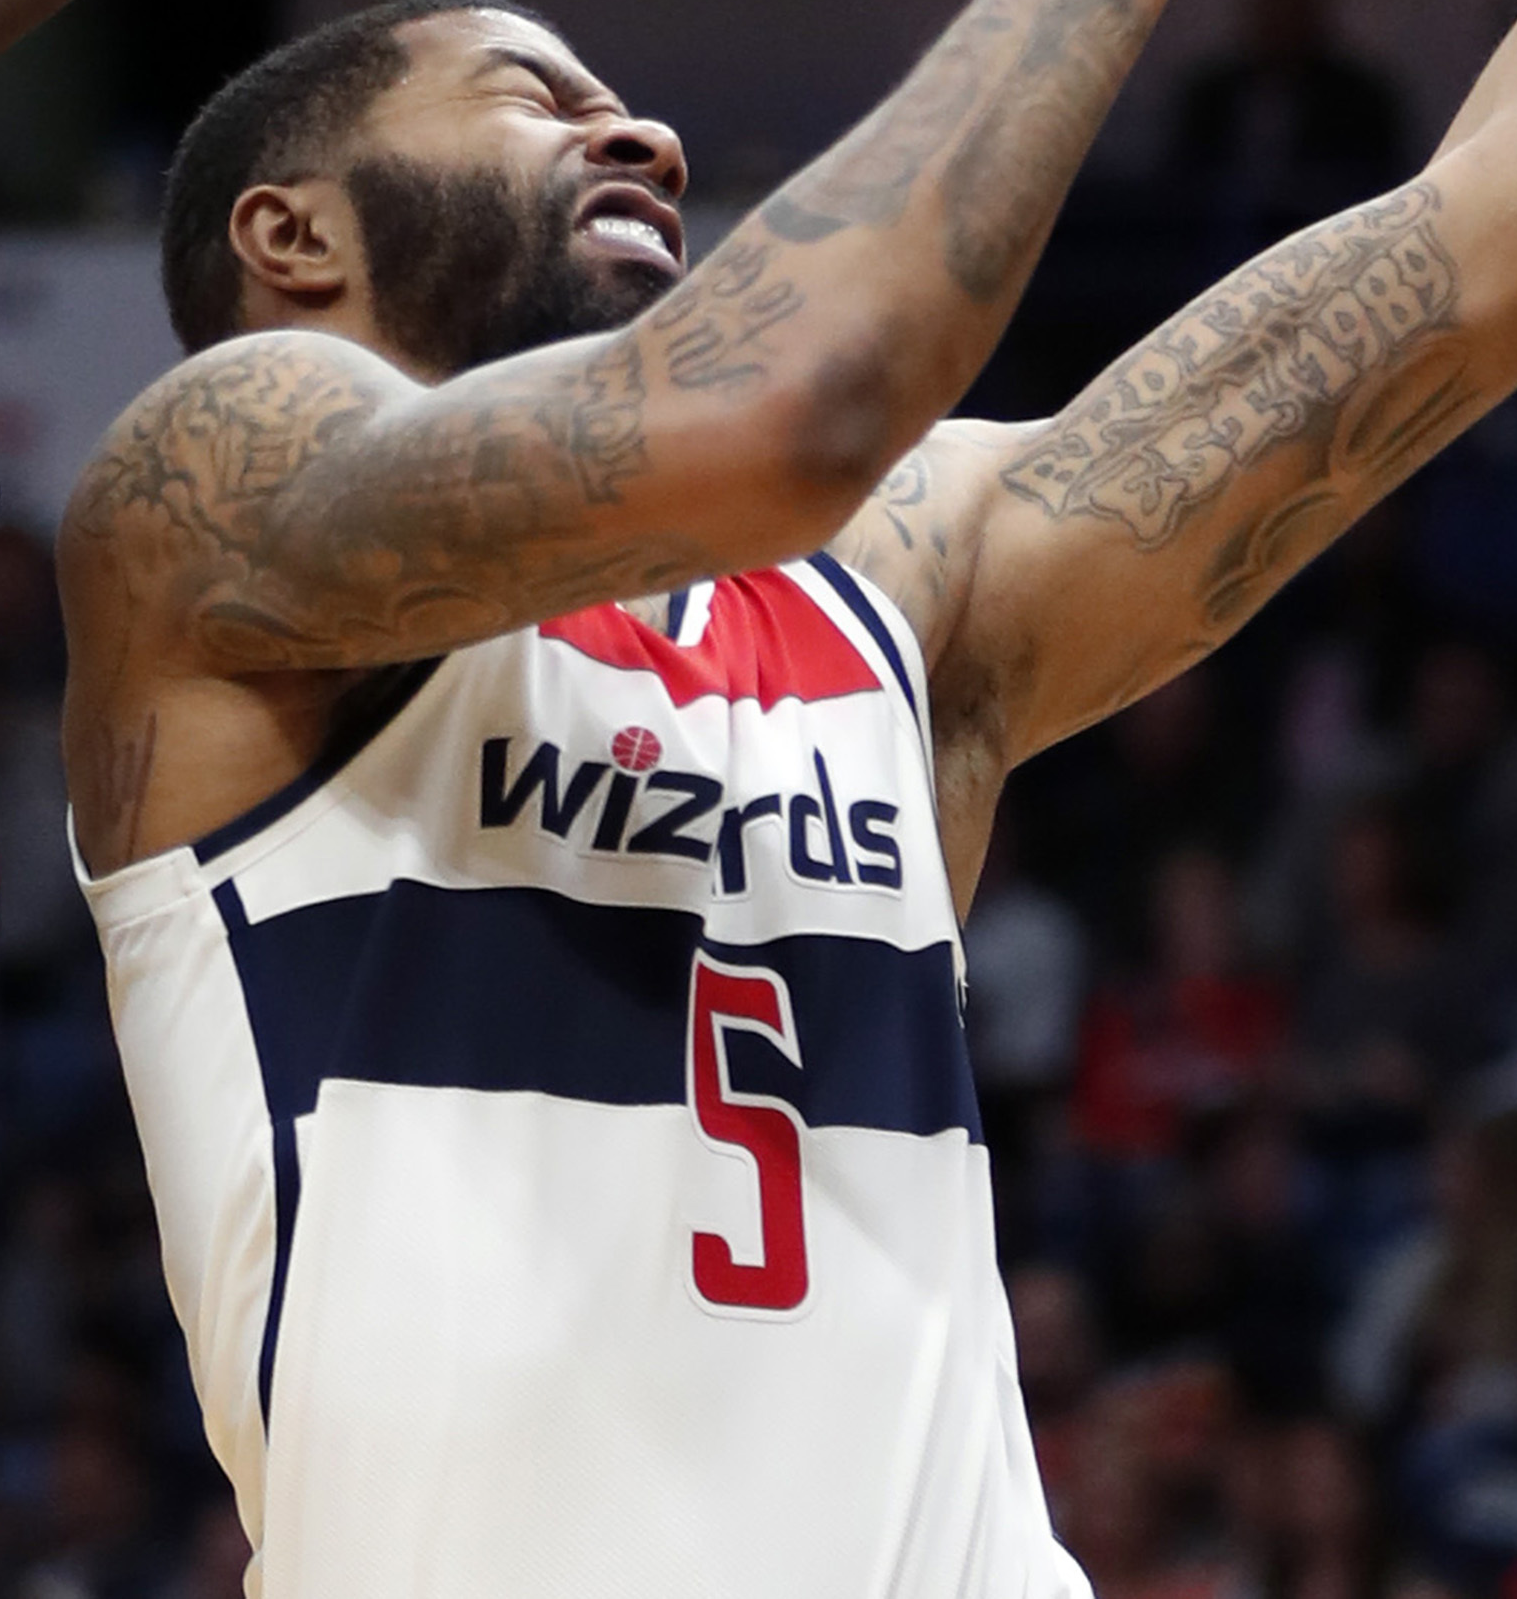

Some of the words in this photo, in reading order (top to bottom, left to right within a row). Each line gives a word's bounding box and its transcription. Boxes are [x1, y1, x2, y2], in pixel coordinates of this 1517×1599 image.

[1288, 220, 1460, 406] 1989
[479, 724, 904, 895] wizrds
[688, 950, 810, 1314] 5
